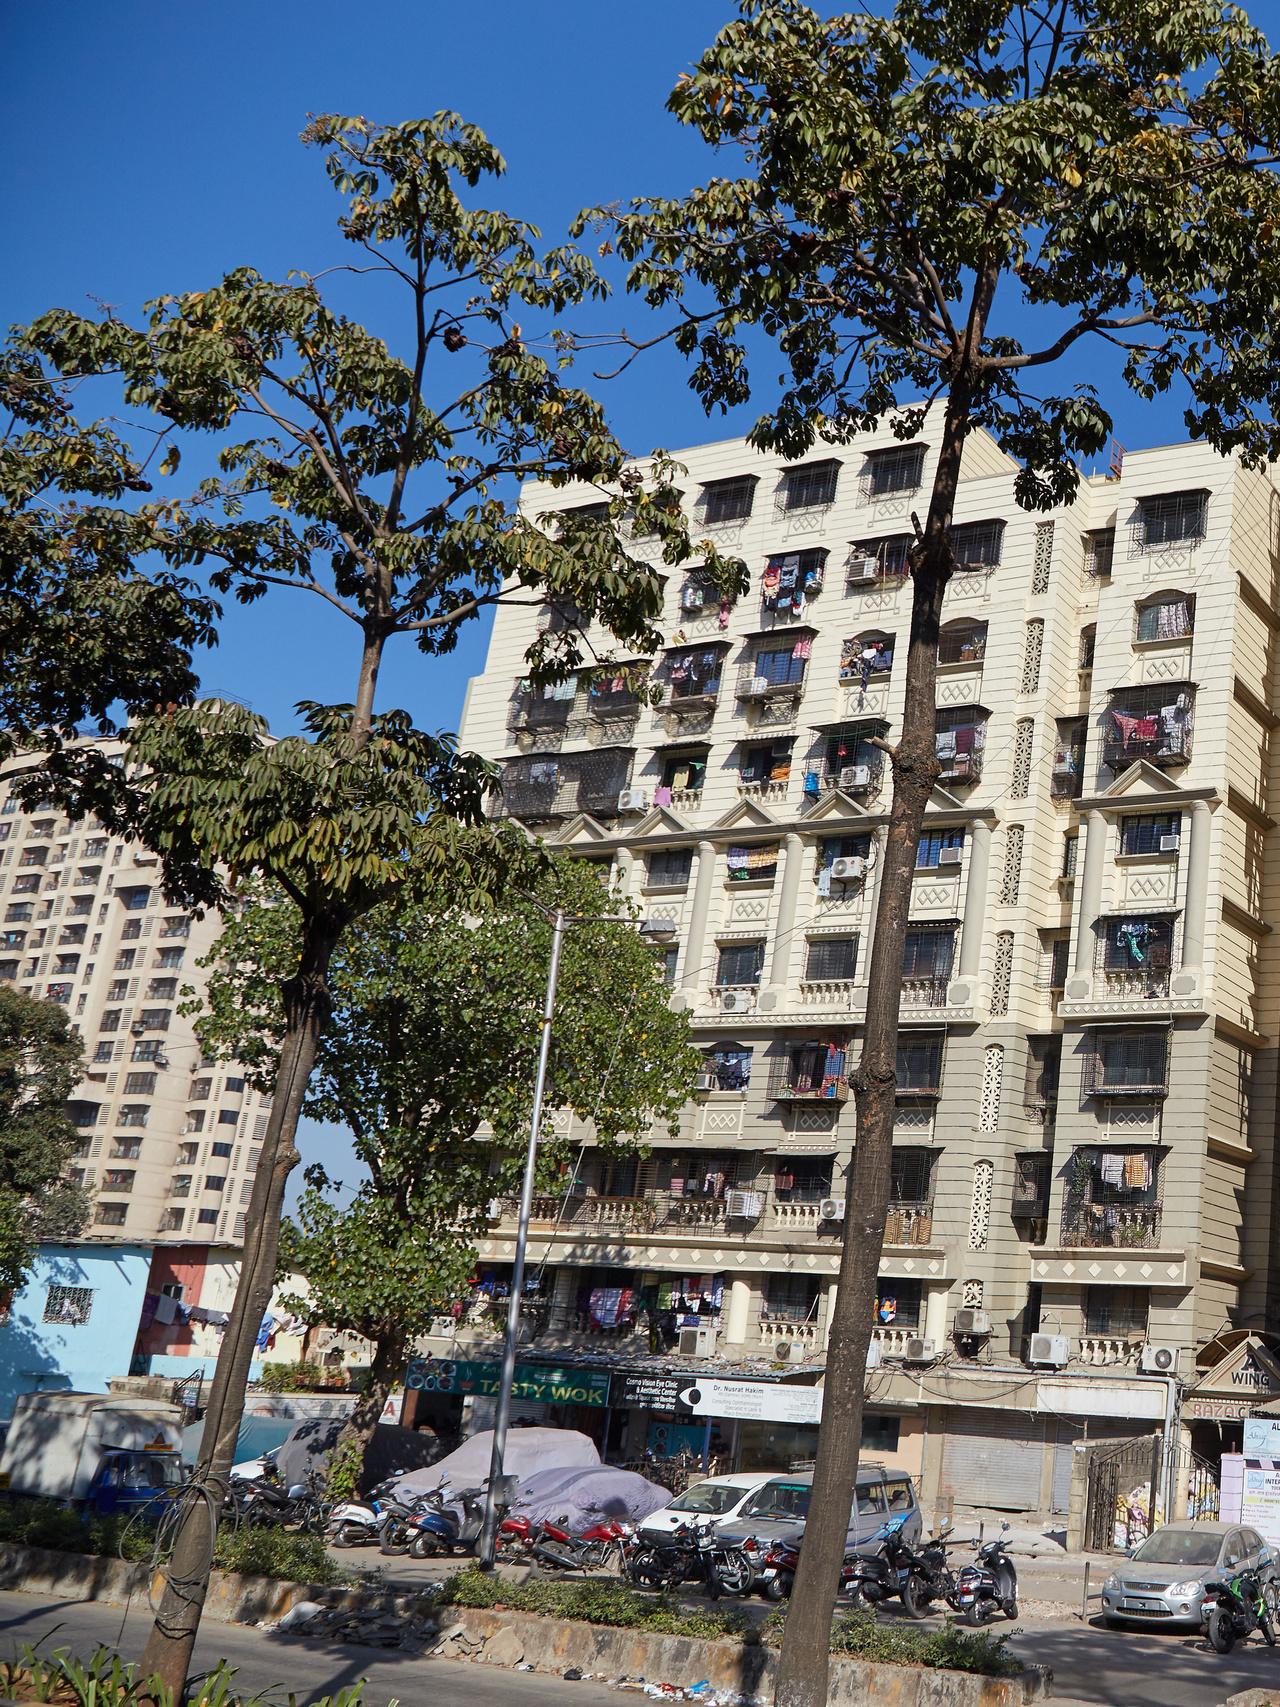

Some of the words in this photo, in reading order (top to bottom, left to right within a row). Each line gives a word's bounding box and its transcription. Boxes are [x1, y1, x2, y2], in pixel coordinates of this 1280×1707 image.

[1239, 1353, 1263, 1372] A
[626, 1378, 642, 1386] Cosmo
[656, 1380, 665, 1388] Eye
[665, 1380, 678, 1388] Clinic
[1231, 1372, 1269, 1386] WING
[661, 1388, 678, 1396] Center
[724, 1385, 744, 1393] Nusrat
[551, 1386, 603, 1404] WOK
[712, 1398, 731, 1406] Consulting
